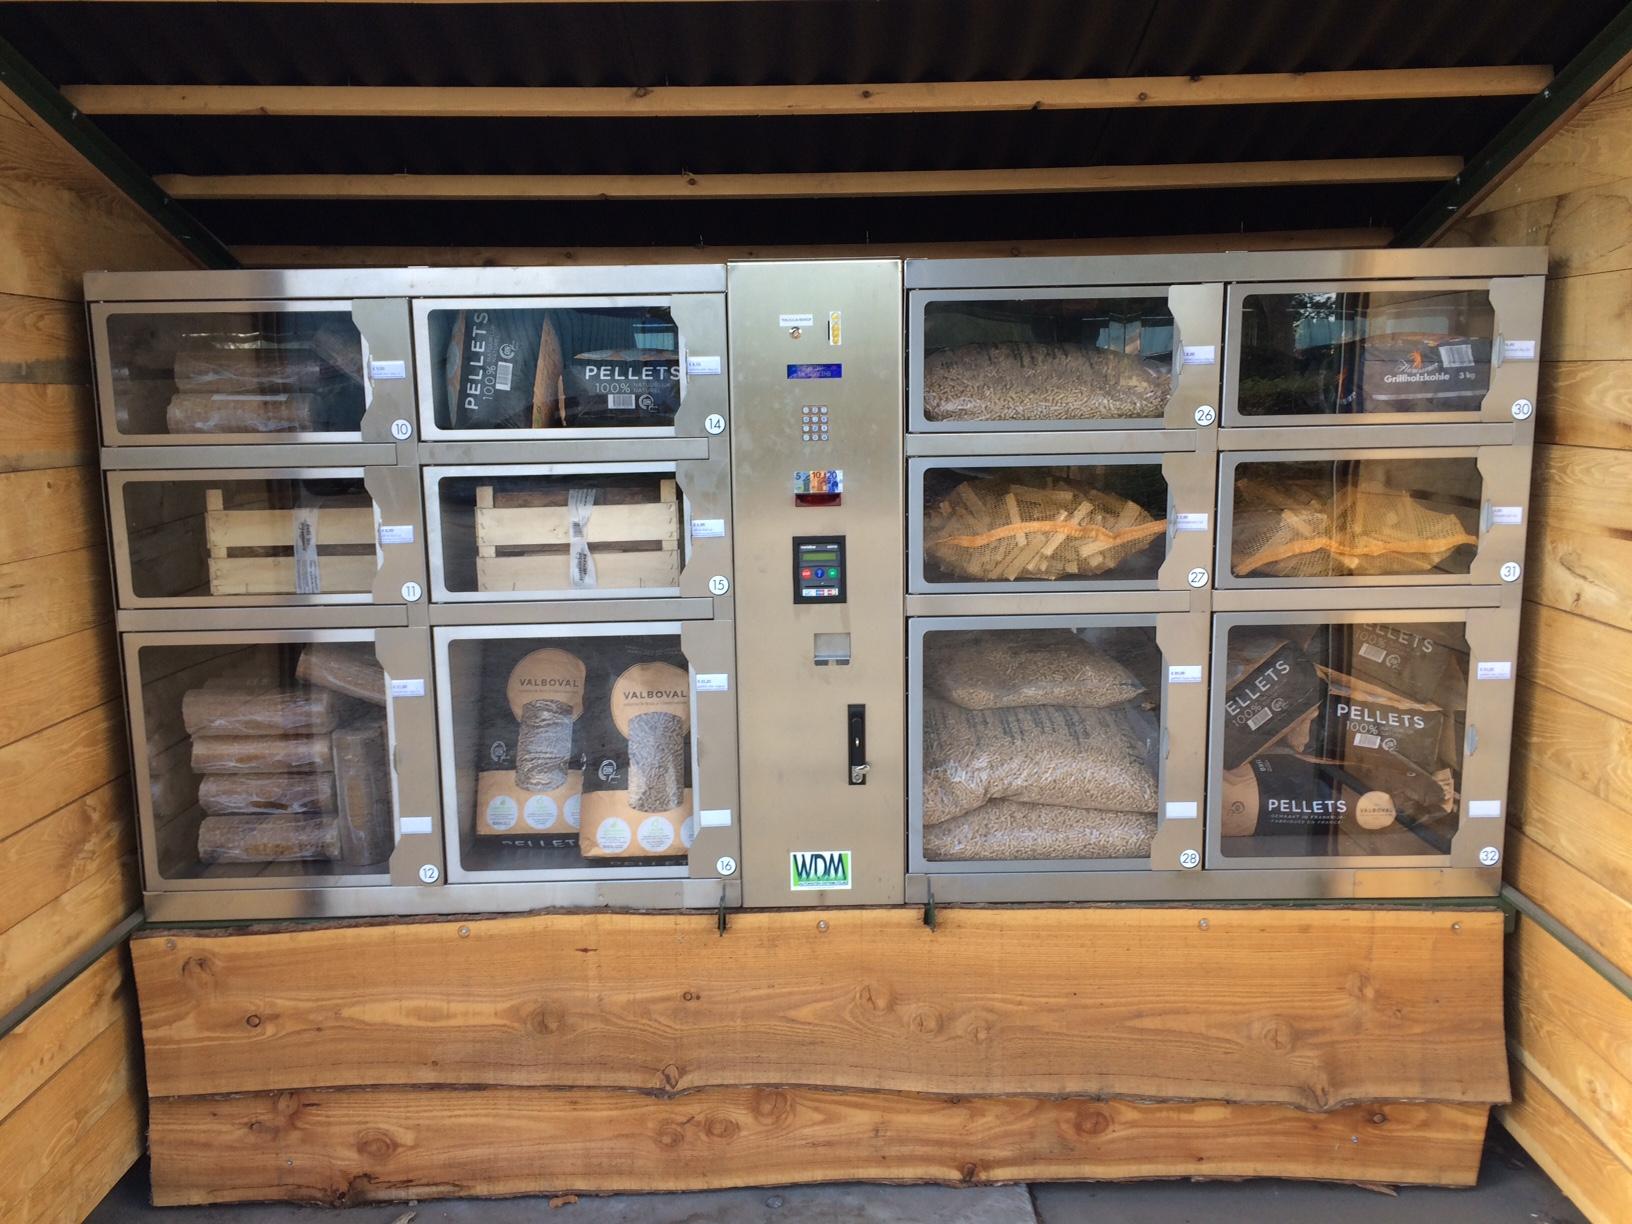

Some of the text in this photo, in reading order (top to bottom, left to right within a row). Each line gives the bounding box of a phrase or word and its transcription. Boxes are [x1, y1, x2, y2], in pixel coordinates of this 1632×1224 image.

[464, 312, 489, 410] PELLETS
[585, 365, 681, 380] PELLETS
[1384, 373, 1450, 384] Grillholzkohle
[1466, 372, 1476, 380] kg
[482, 364, 497, 400] 100%
[595, 382, 631, 393] 100%
[1513, 403, 1530, 415] 30
[1197, 410, 1213, 421] 26
[395, 423, 408, 435] 10
[709, 418, 726, 430] 14
[795, 472, 801, 480] 5
[828, 471, 837, 479] 20
[1191, 571, 1206, 583] 27
[1503, 565, 1516, 577] 31
[406, 585, 416, 597] 11
[712, 579, 725, 591] 15
[519, 678, 579, 688] VALBOVAL
[623, 690, 688, 700] VALBOVAL
[1336, 703, 1425, 729] PELLETS
[1346, 721, 1378, 735] 100%
[1268, 799, 1347, 813] PELLETS
[1183, 853, 1196, 864] 28
[1482, 850, 1496, 861] 32
[720, 860, 732, 871] 16
[793, 853, 847, 881] WDM
[423, 867, 434, 879] 12
